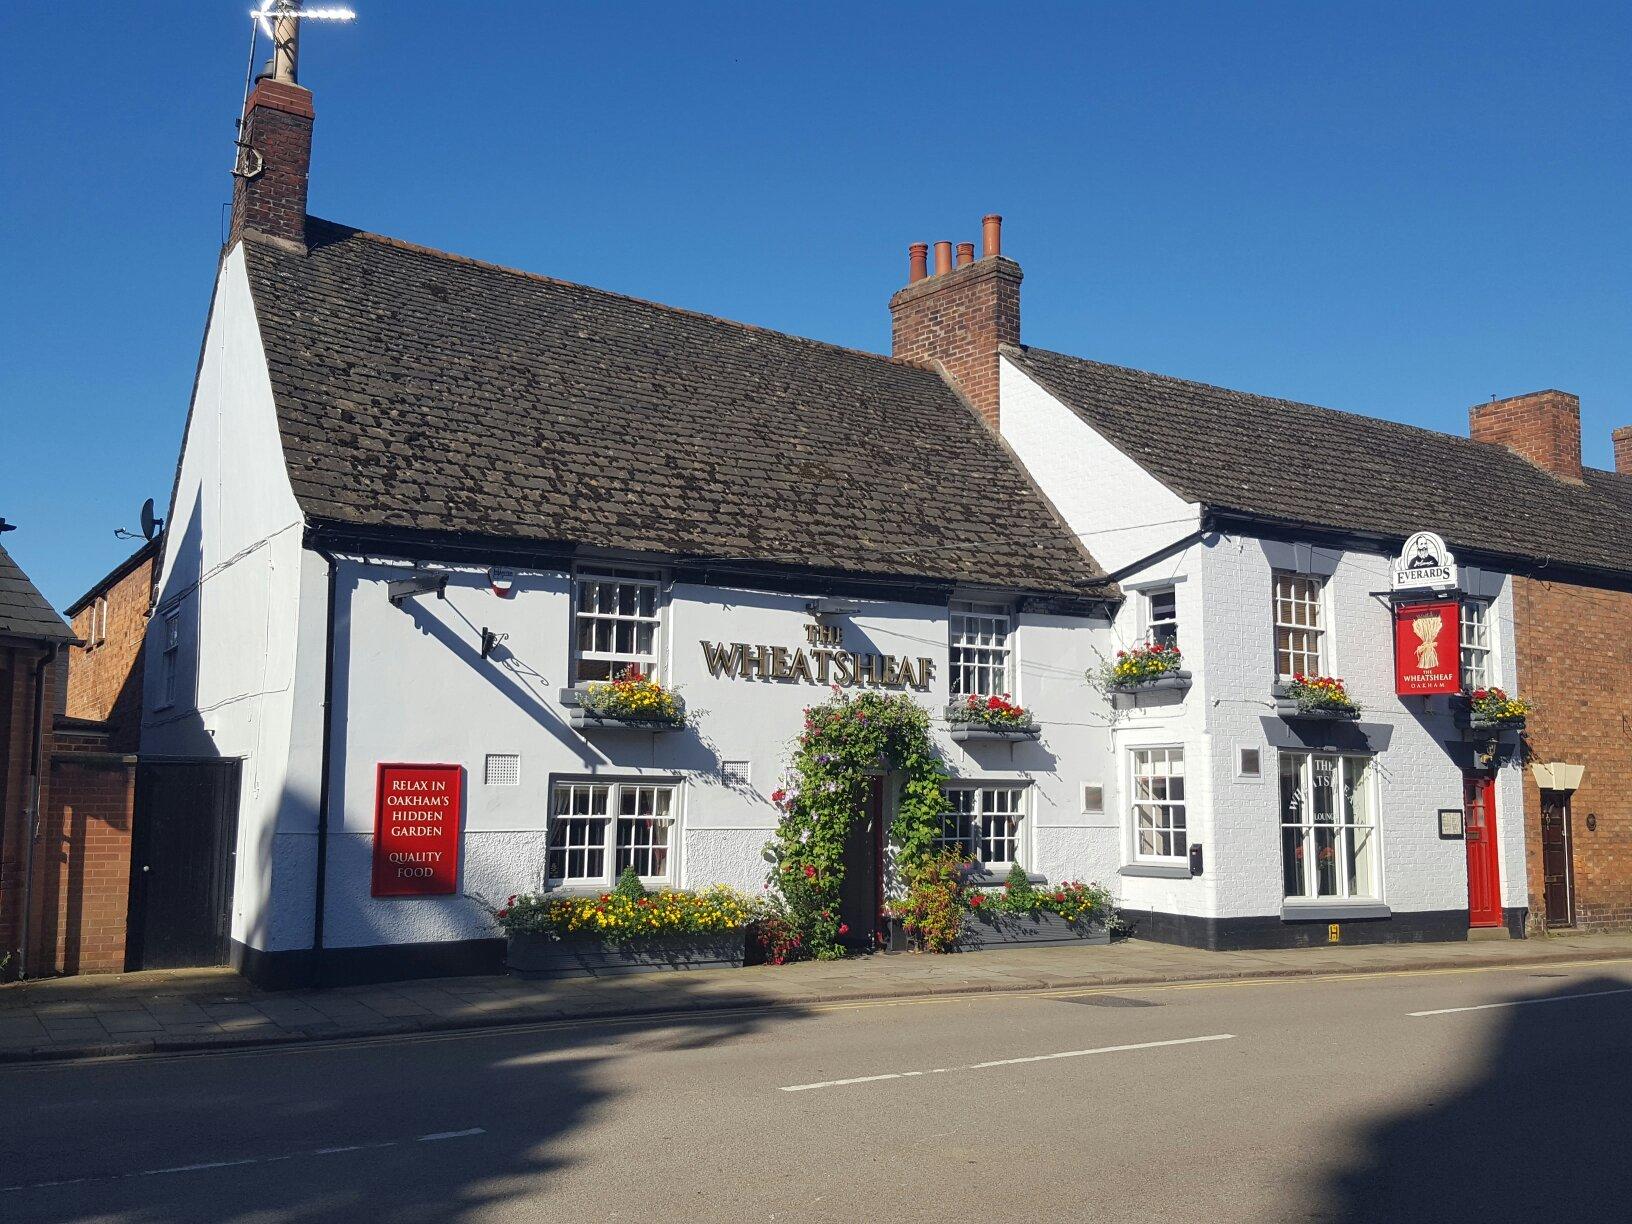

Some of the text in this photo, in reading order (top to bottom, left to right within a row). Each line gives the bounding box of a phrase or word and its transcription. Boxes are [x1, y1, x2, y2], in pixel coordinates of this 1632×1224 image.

[1397, 567, 1451, 584] EVERARDS
[803, 623, 843, 645] THE
[699, 640, 934, 690] WHEATSHEAF
[1403, 673, 1453, 682] WHEATSHEAF
[392, 780, 446, 791] RELAX IN
[387, 795, 450, 806] OAKHAM'S
[392, 811, 443, 821] HIDDEN
[391, 826, 442, 837] GARDEN
[389, 852, 442, 864] QUALITY
[397, 867, 434, 878] FOOD
